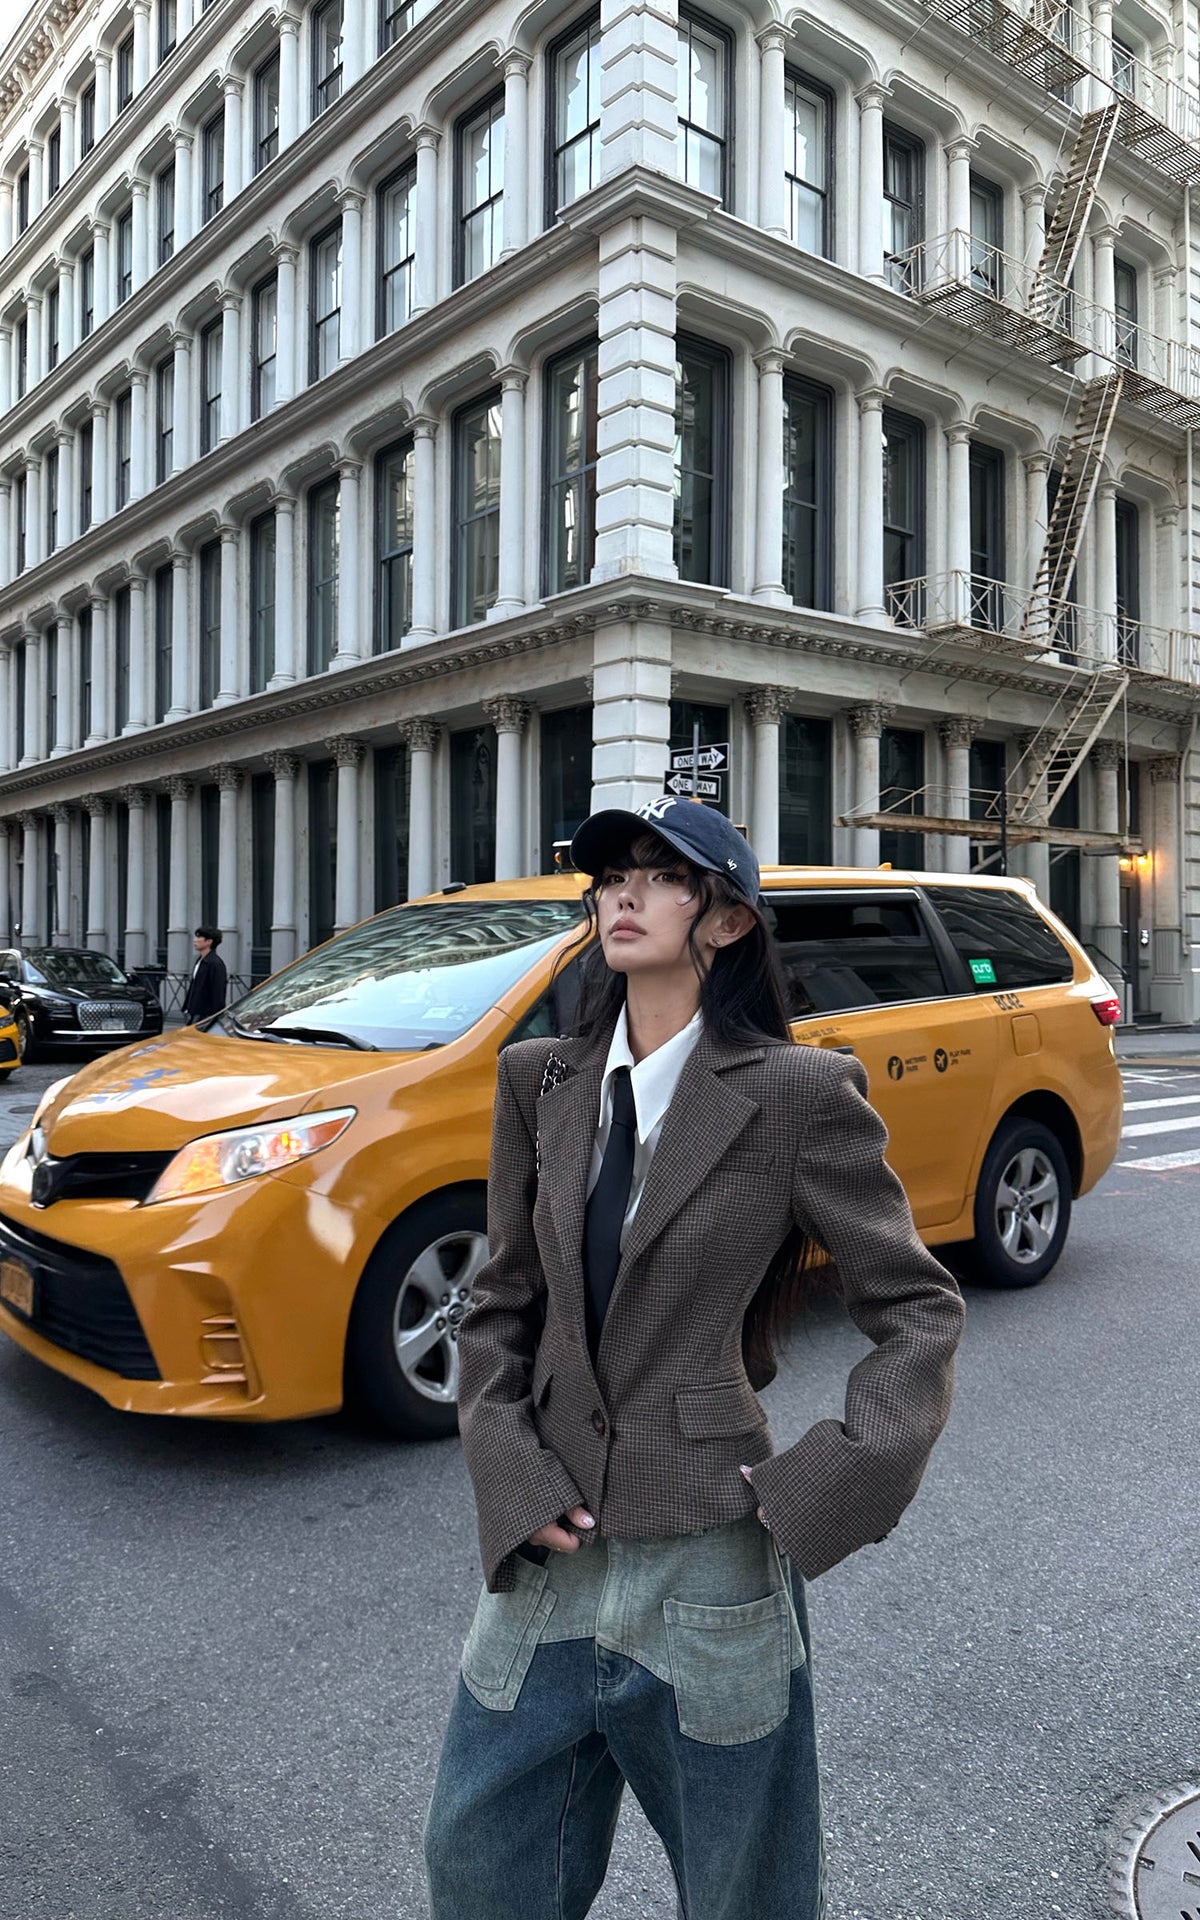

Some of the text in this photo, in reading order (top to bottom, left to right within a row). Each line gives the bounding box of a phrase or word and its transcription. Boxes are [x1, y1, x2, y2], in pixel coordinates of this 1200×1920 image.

[677, 753, 719, 767] ONE WAY
[672, 779, 713, 792] ONE WAY
[972, 963, 992, 973] curb
